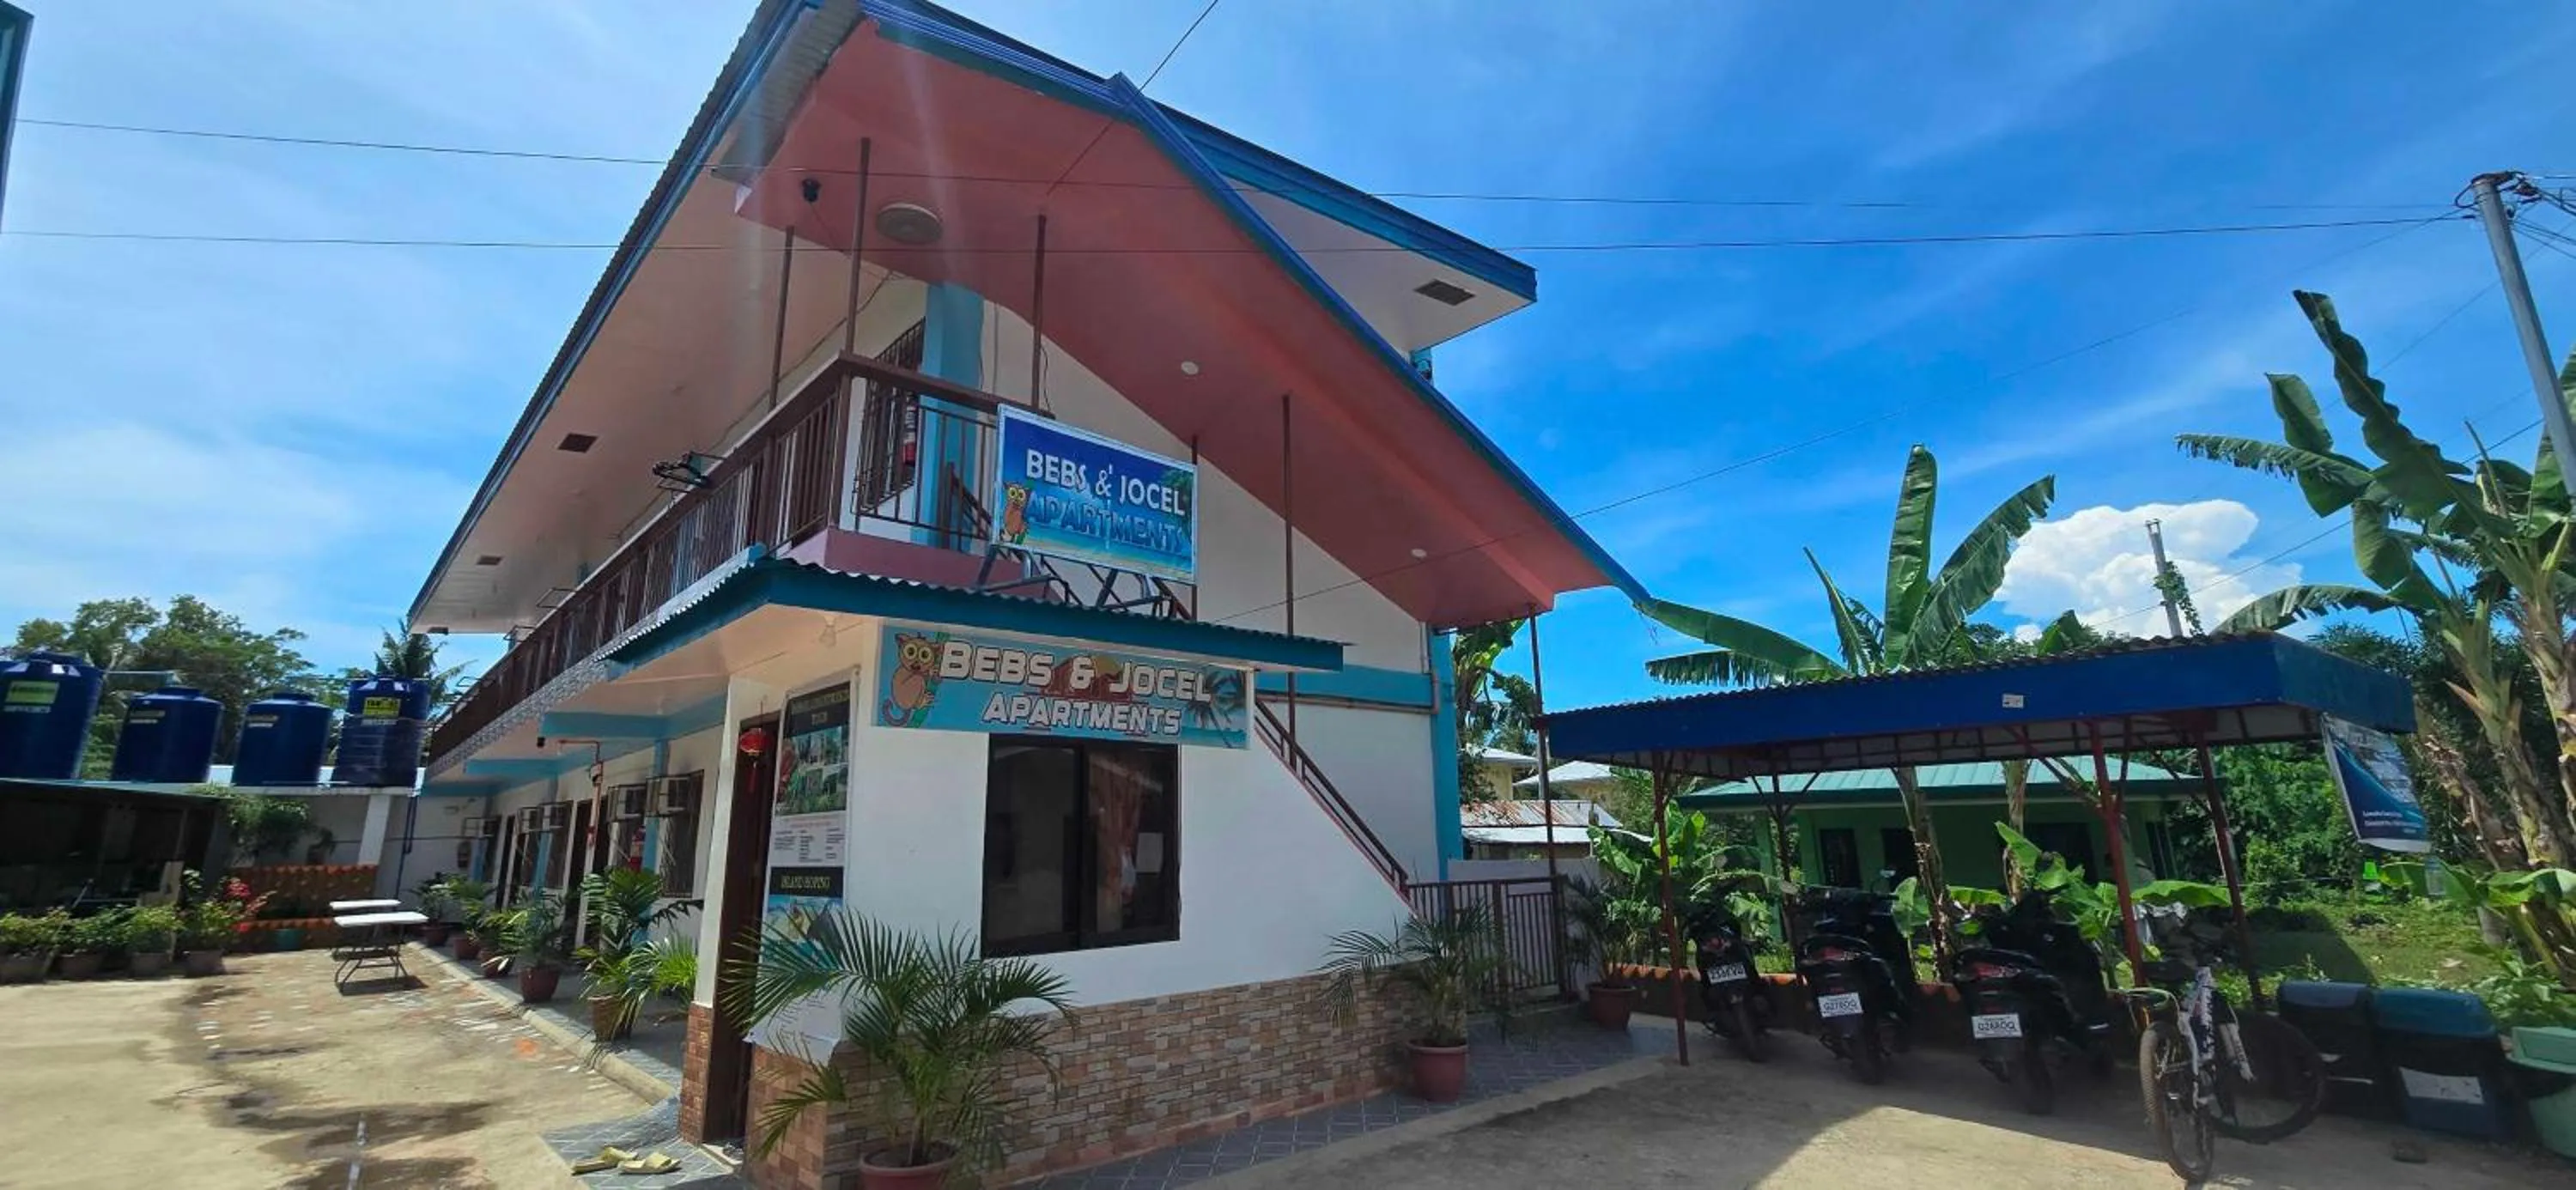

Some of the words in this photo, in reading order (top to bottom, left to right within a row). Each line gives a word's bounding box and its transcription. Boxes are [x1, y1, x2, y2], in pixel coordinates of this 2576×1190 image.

[1026, 449, 1086, 490] BEBS
[1119, 475, 1185, 516] JOCEL
[939, 641, 1054, 688] BEBS
[1070, 655, 1097, 691] &
[1109, 662, 1212, 702] JOCEL
[982, 692, 1183, 736] APARTMENTS
